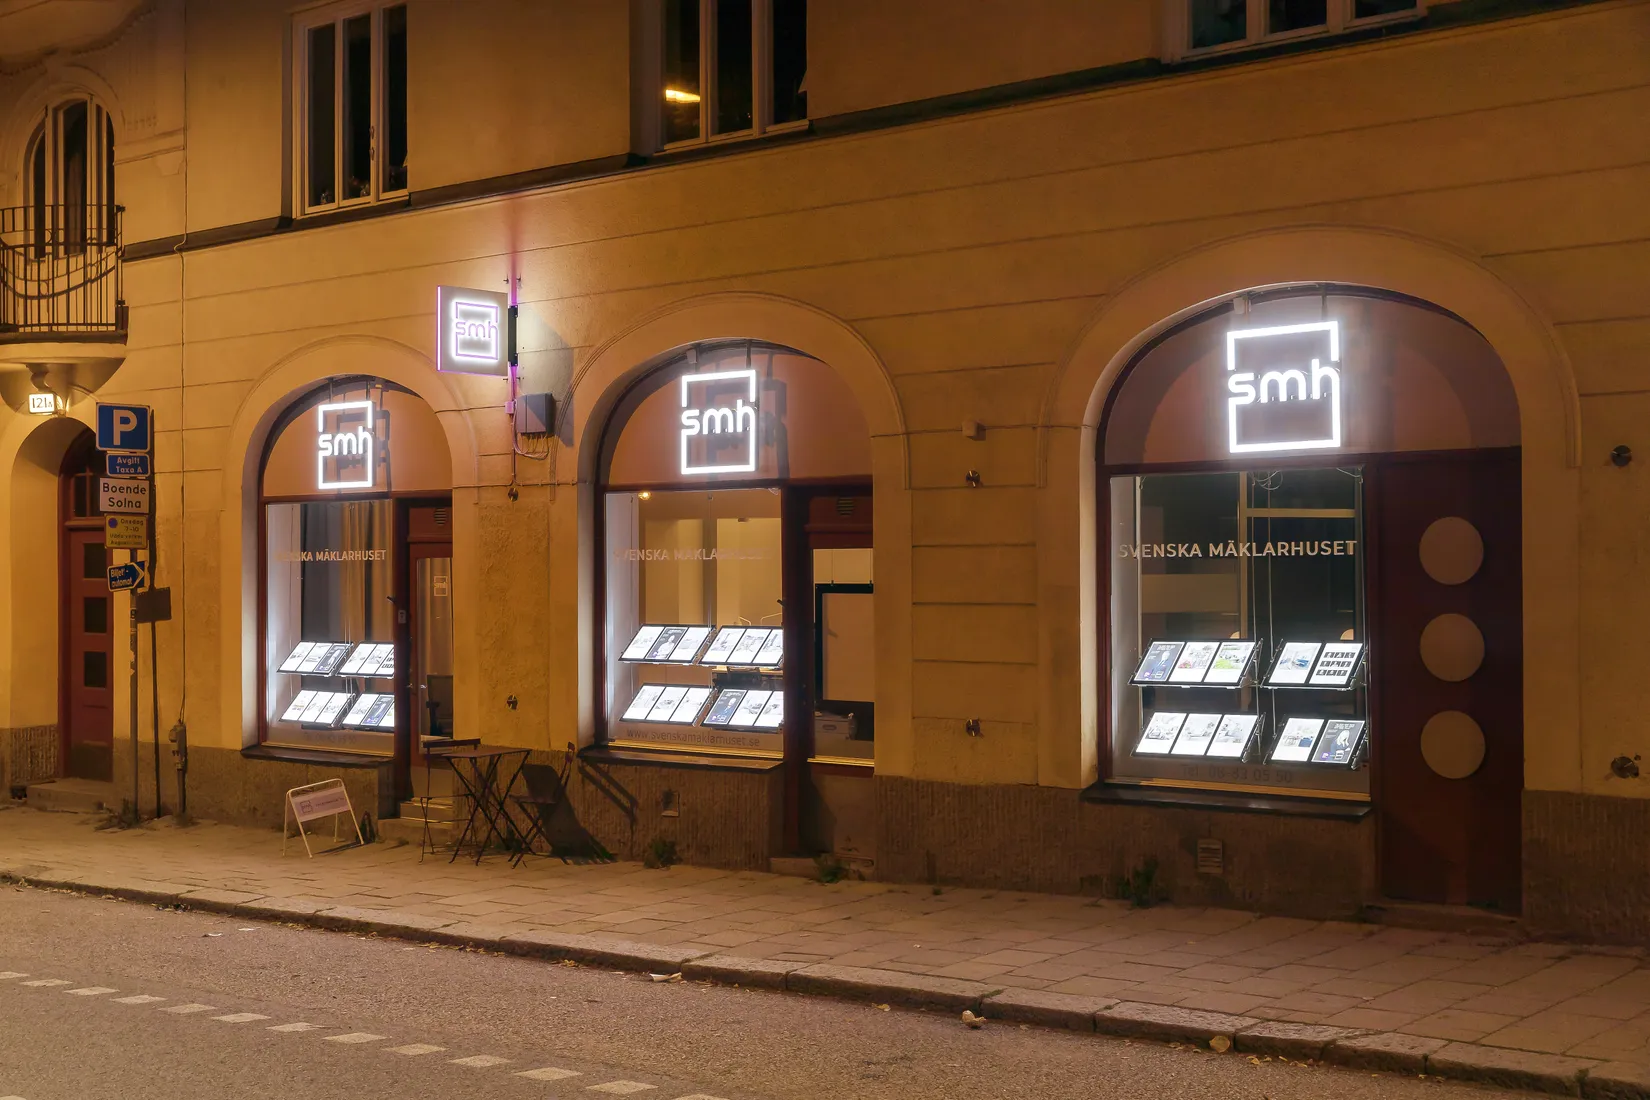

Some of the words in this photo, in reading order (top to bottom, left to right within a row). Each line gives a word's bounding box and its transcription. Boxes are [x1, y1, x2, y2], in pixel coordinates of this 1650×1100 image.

[455, 319, 499, 339] smh
[1228, 358, 1340, 405] smh
[681, 399, 756, 436] smh
[113, 409, 138, 446] P
[318, 426, 373, 456] smh
[117, 457, 140, 465] Avgift
[103, 482, 146, 495] Boende
[108, 497, 141, 509] Solna
[316, 549, 386, 561] MÄKLARHUSET
[613, 549, 669, 561] VENSKA
[1119, 543, 1202, 558] SVENSKA
[1209, 540, 1357, 557] MÄKLARHUSET
